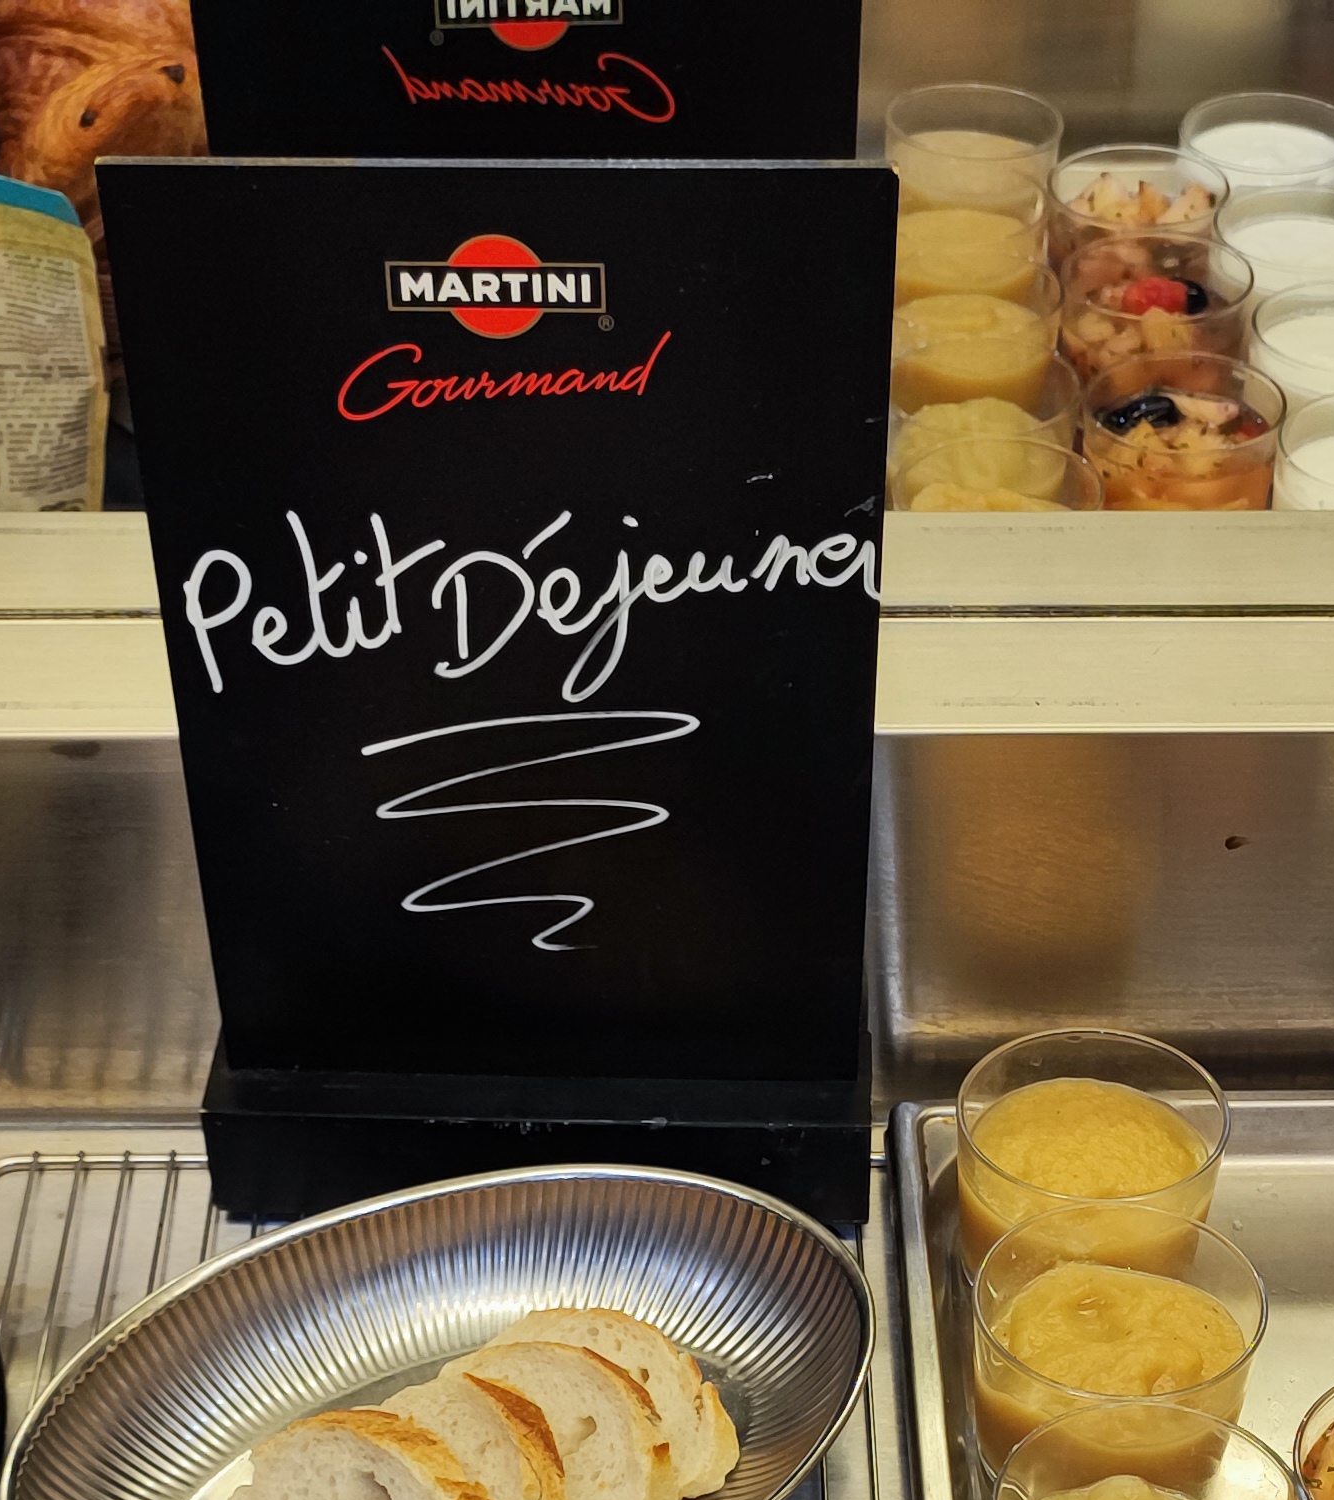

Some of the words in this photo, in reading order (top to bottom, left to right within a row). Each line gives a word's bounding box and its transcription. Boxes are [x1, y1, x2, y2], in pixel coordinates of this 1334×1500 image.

[399, 272, 593, 302] MARTINI
[338, 332, 672, 422] Gourmand
[183, 510, 445, 694] Petit
